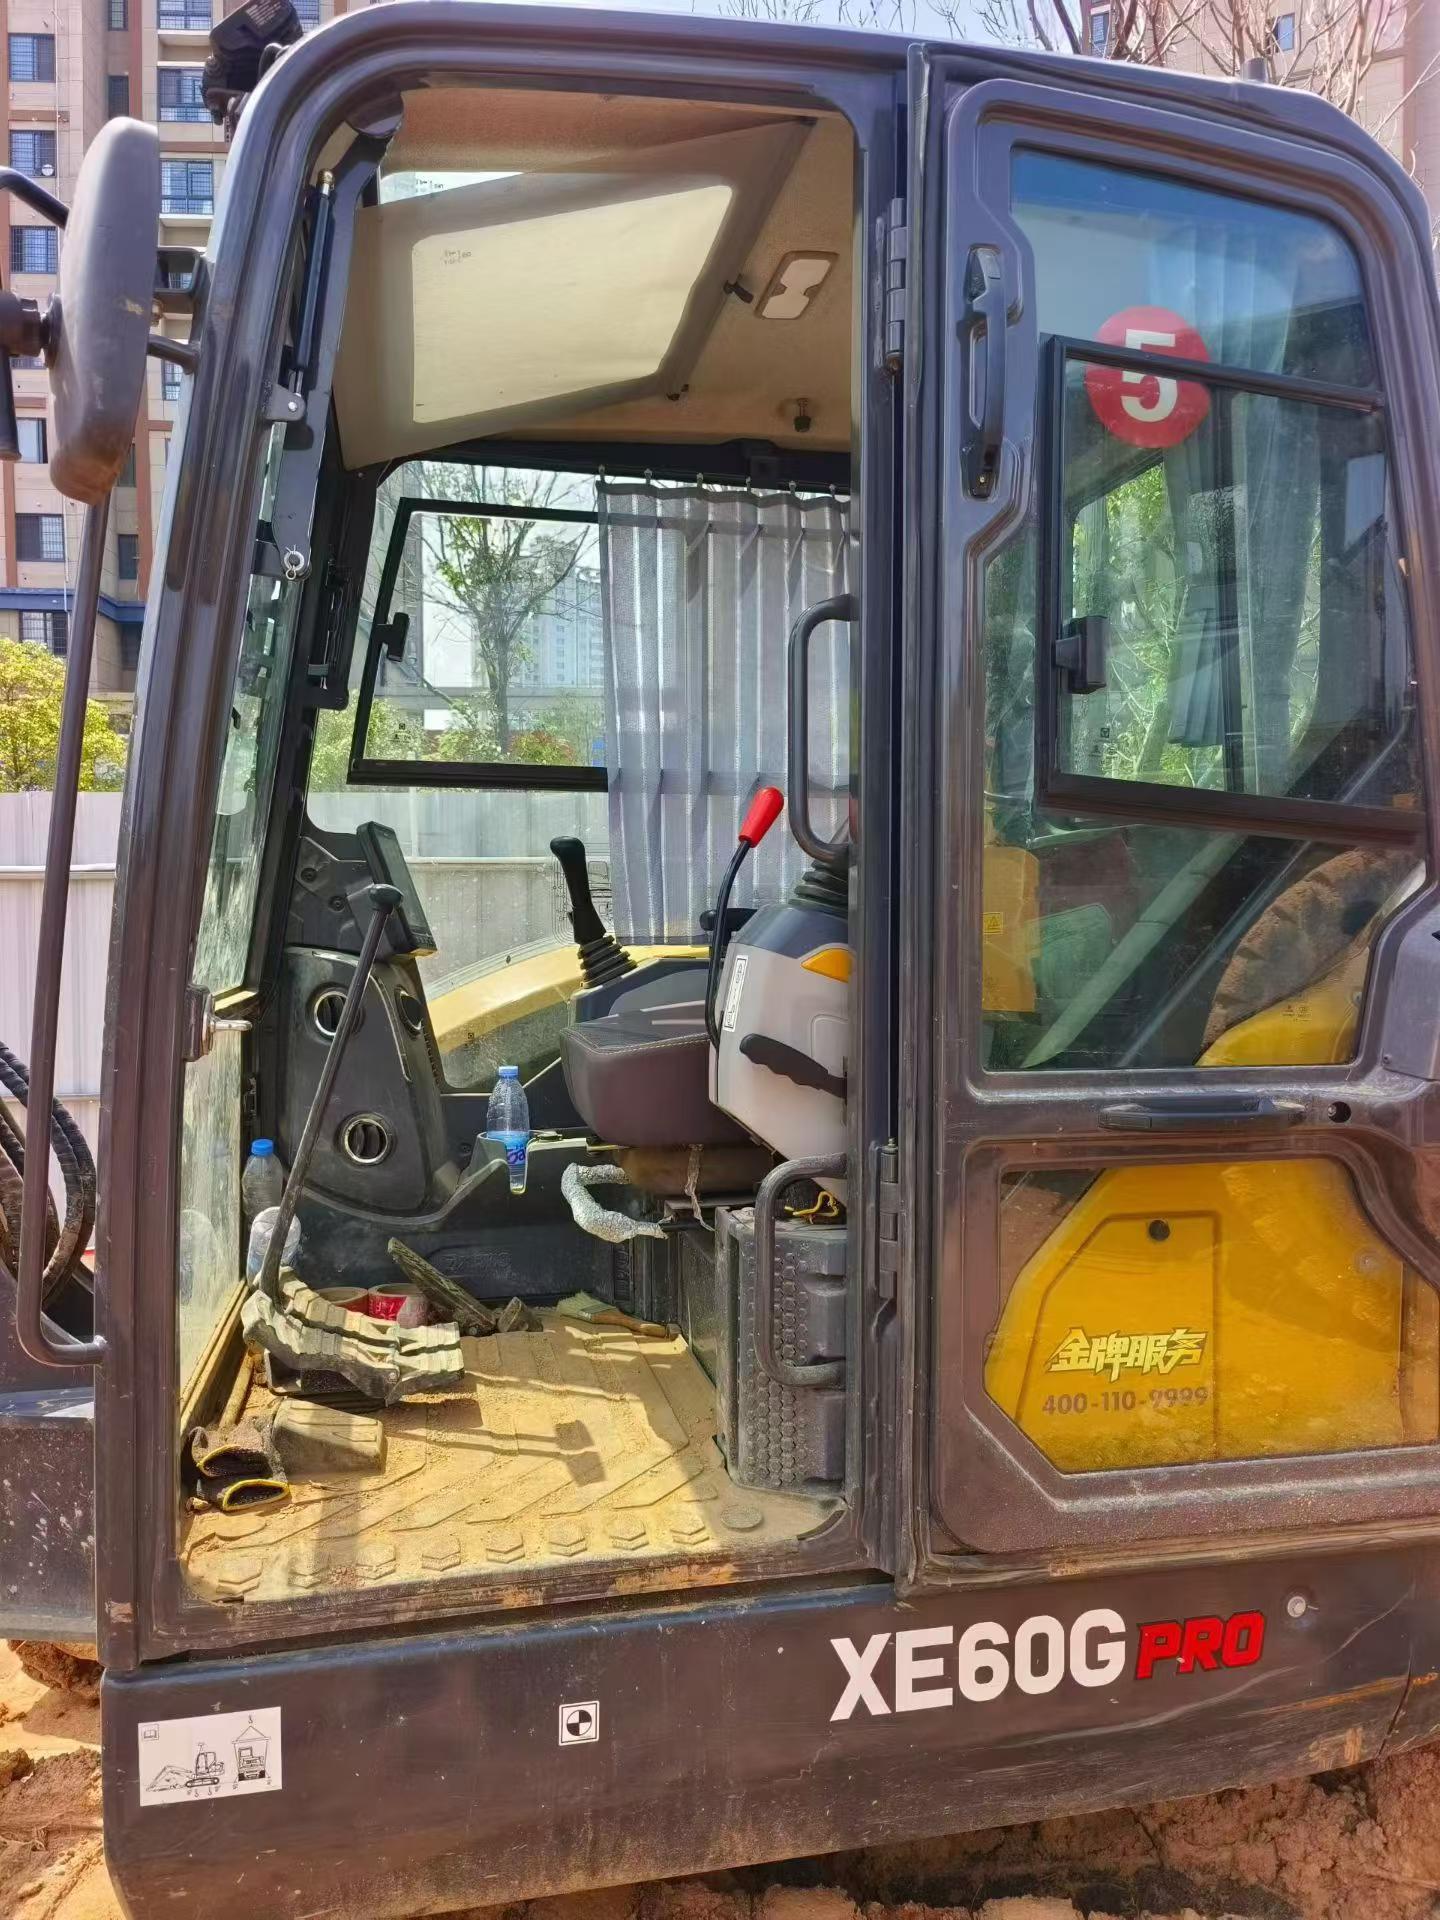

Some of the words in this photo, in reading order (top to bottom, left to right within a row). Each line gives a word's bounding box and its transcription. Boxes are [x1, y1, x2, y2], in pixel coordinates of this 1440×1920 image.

[1120, 328, 1178, 423] 5
[1045, 1327, 1207, 1383] 金牌服务
[829, 1608, 1126, 1722] XE60G
[1134, 1609, 1265, 1680] PRO
